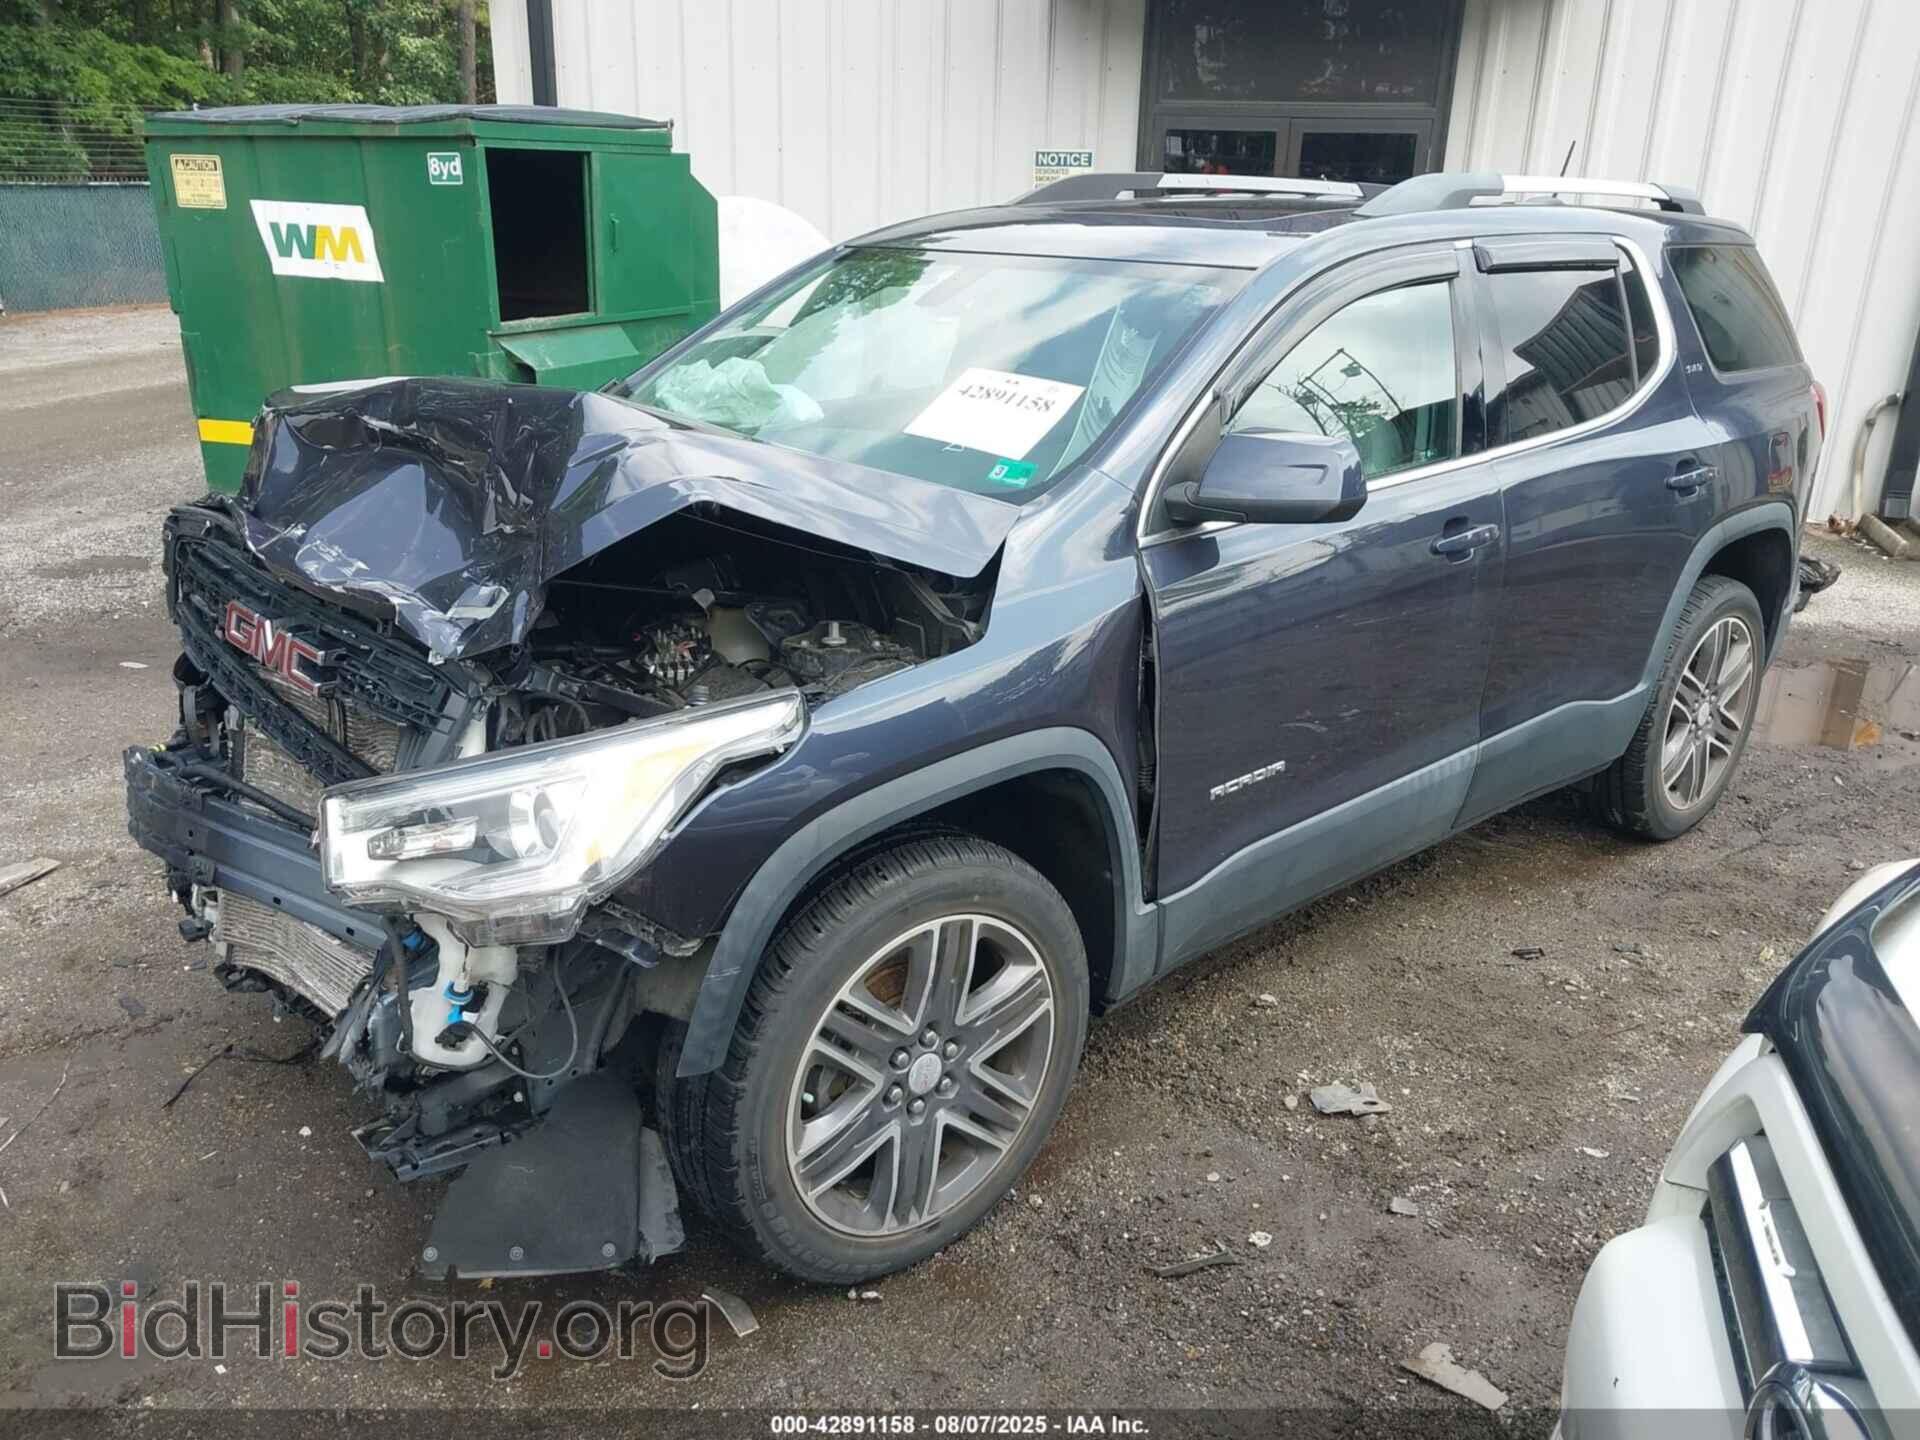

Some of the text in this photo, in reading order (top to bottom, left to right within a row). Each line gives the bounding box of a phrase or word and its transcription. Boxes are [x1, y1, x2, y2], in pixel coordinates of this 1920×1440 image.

[183, 159, 216, 171] CAUTION
[430, 157, 461, 179] 8yd
[1038, 152, 1089, 166] NOTICE
[269, 222, 366, 264] WM
[958, 384, 1057, 412] 42891158
[224, 600, 326, 697] GMC
[1209, 759, 1286, 801] ACADIA
